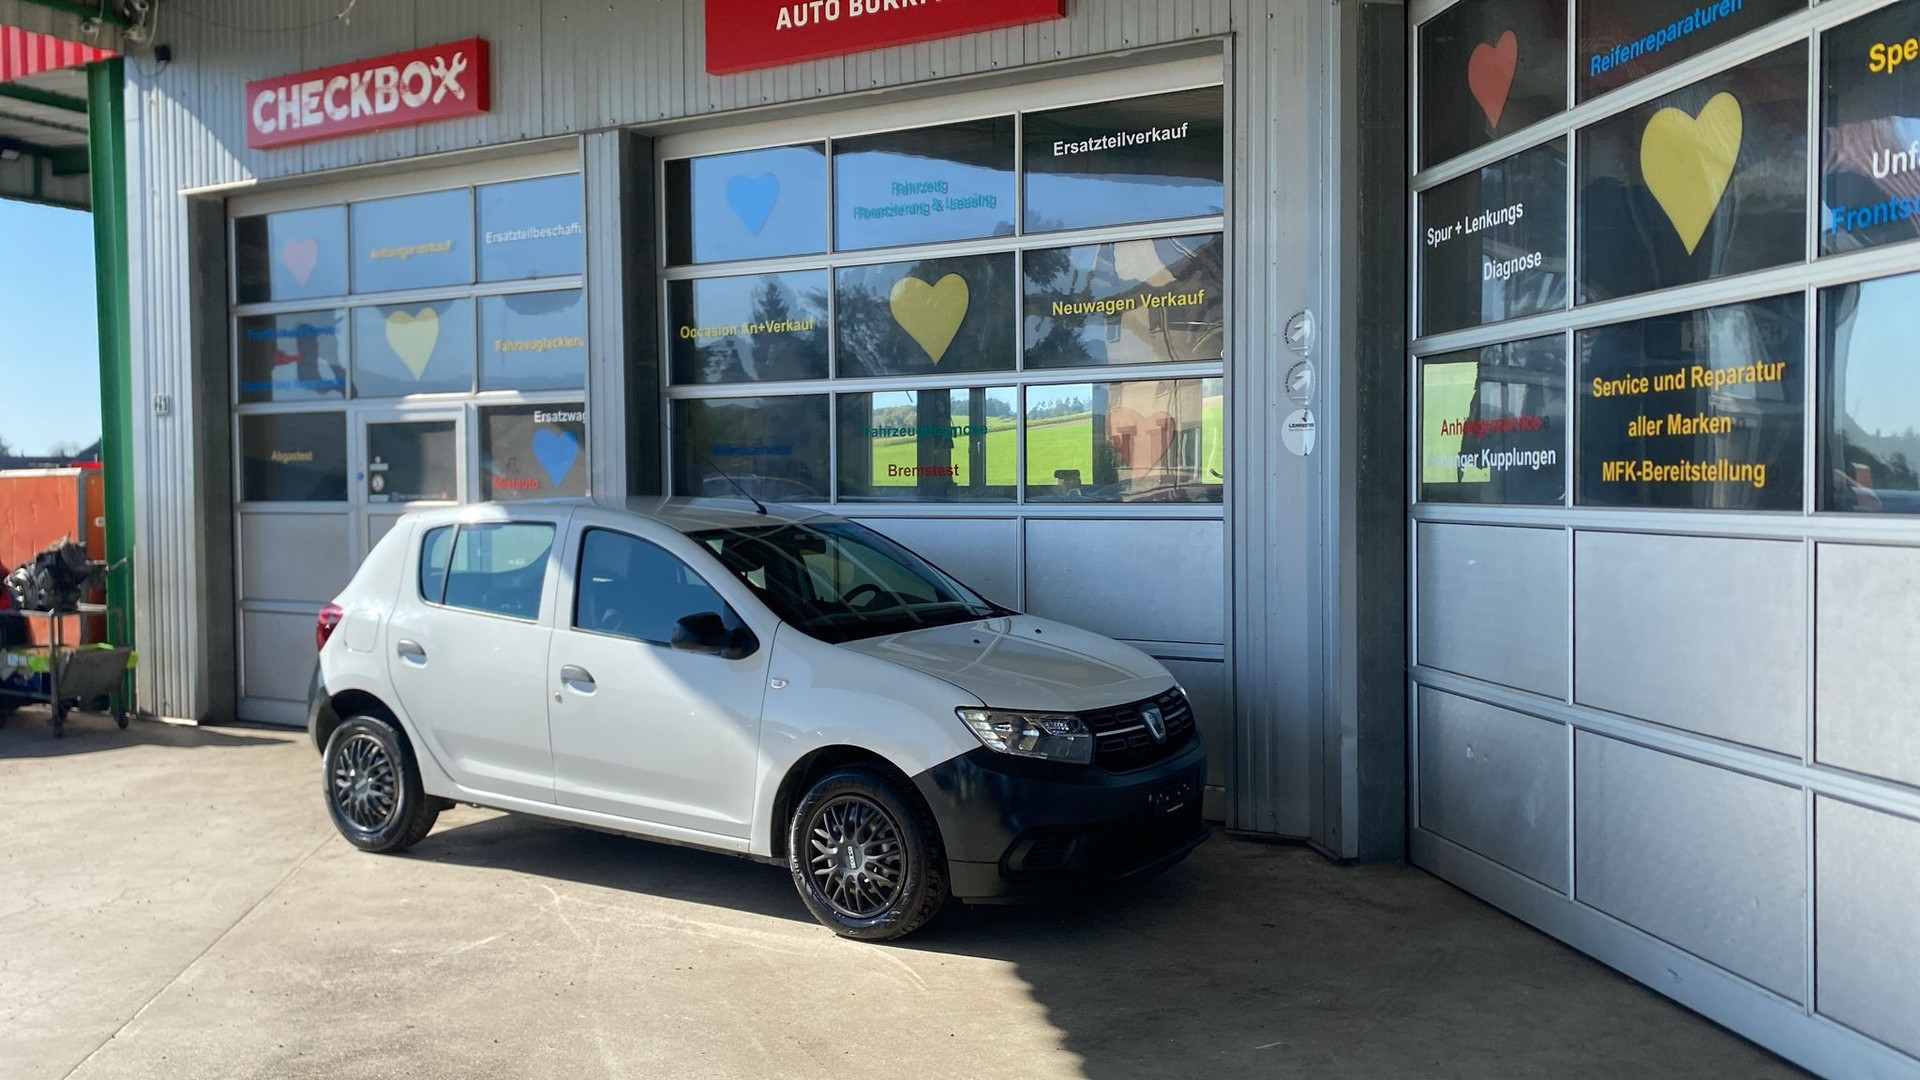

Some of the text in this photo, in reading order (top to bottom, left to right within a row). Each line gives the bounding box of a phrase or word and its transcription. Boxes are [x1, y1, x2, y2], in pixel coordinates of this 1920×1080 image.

[775, 0, 840, 30] AUTO
[1590, 0, 1743, 77] Reifenreparaturen
[1869, 38, 1920, 74] Spe
[252, 52, 468, 134] CHECKBOX
[1053, 122, 1188, 156] Ersatzteilverkauf
[1872, 141, 1920, 179] Unf
[1427, 203, 1524, 248] Spur + Lenkungs
[1483, 251, 1542, 281] Diagnose
[1052, 289, 1205, 316] Neuwagen Verkauf
[680, 325, 737, 339] Occasion
[1592, 360, 1786, 398] Service und Reparatur
[1628, 412, 1732, 437] aller Marken
[888, 464, 959, 477] Bremstest
[1481, 447, 1556, 471] Kupplungen
[1602, 459, 1766, 488] MFK-Bereitstellung
